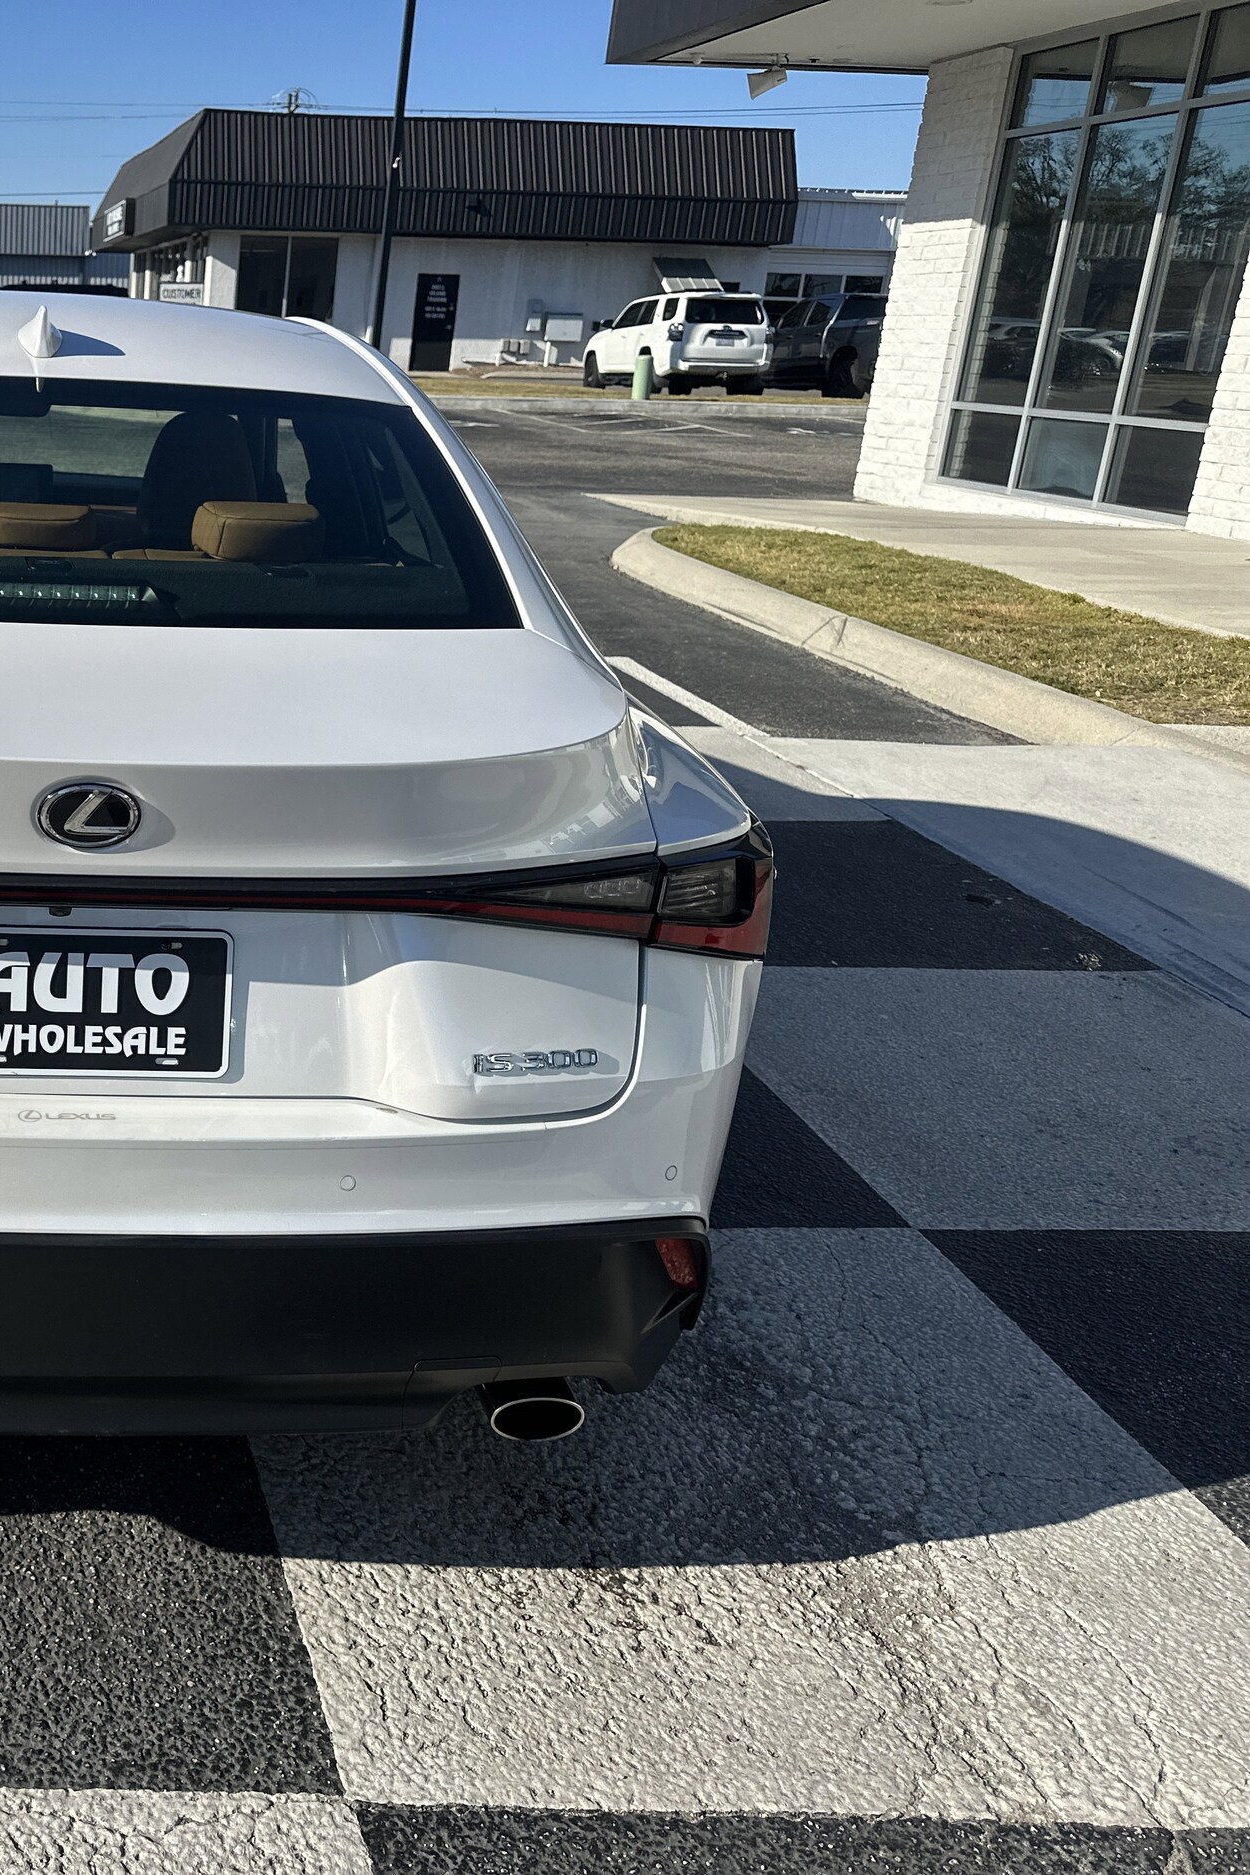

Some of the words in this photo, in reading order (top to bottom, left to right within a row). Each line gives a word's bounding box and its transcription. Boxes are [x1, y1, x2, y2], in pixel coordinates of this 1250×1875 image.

[162, 288, 202, 299] CUSTOMER
[473, 1053, 514, 1074] IS
[517, 1048, 599, 1072] 300
[45, 1113, 117, 1121] LEXUS
